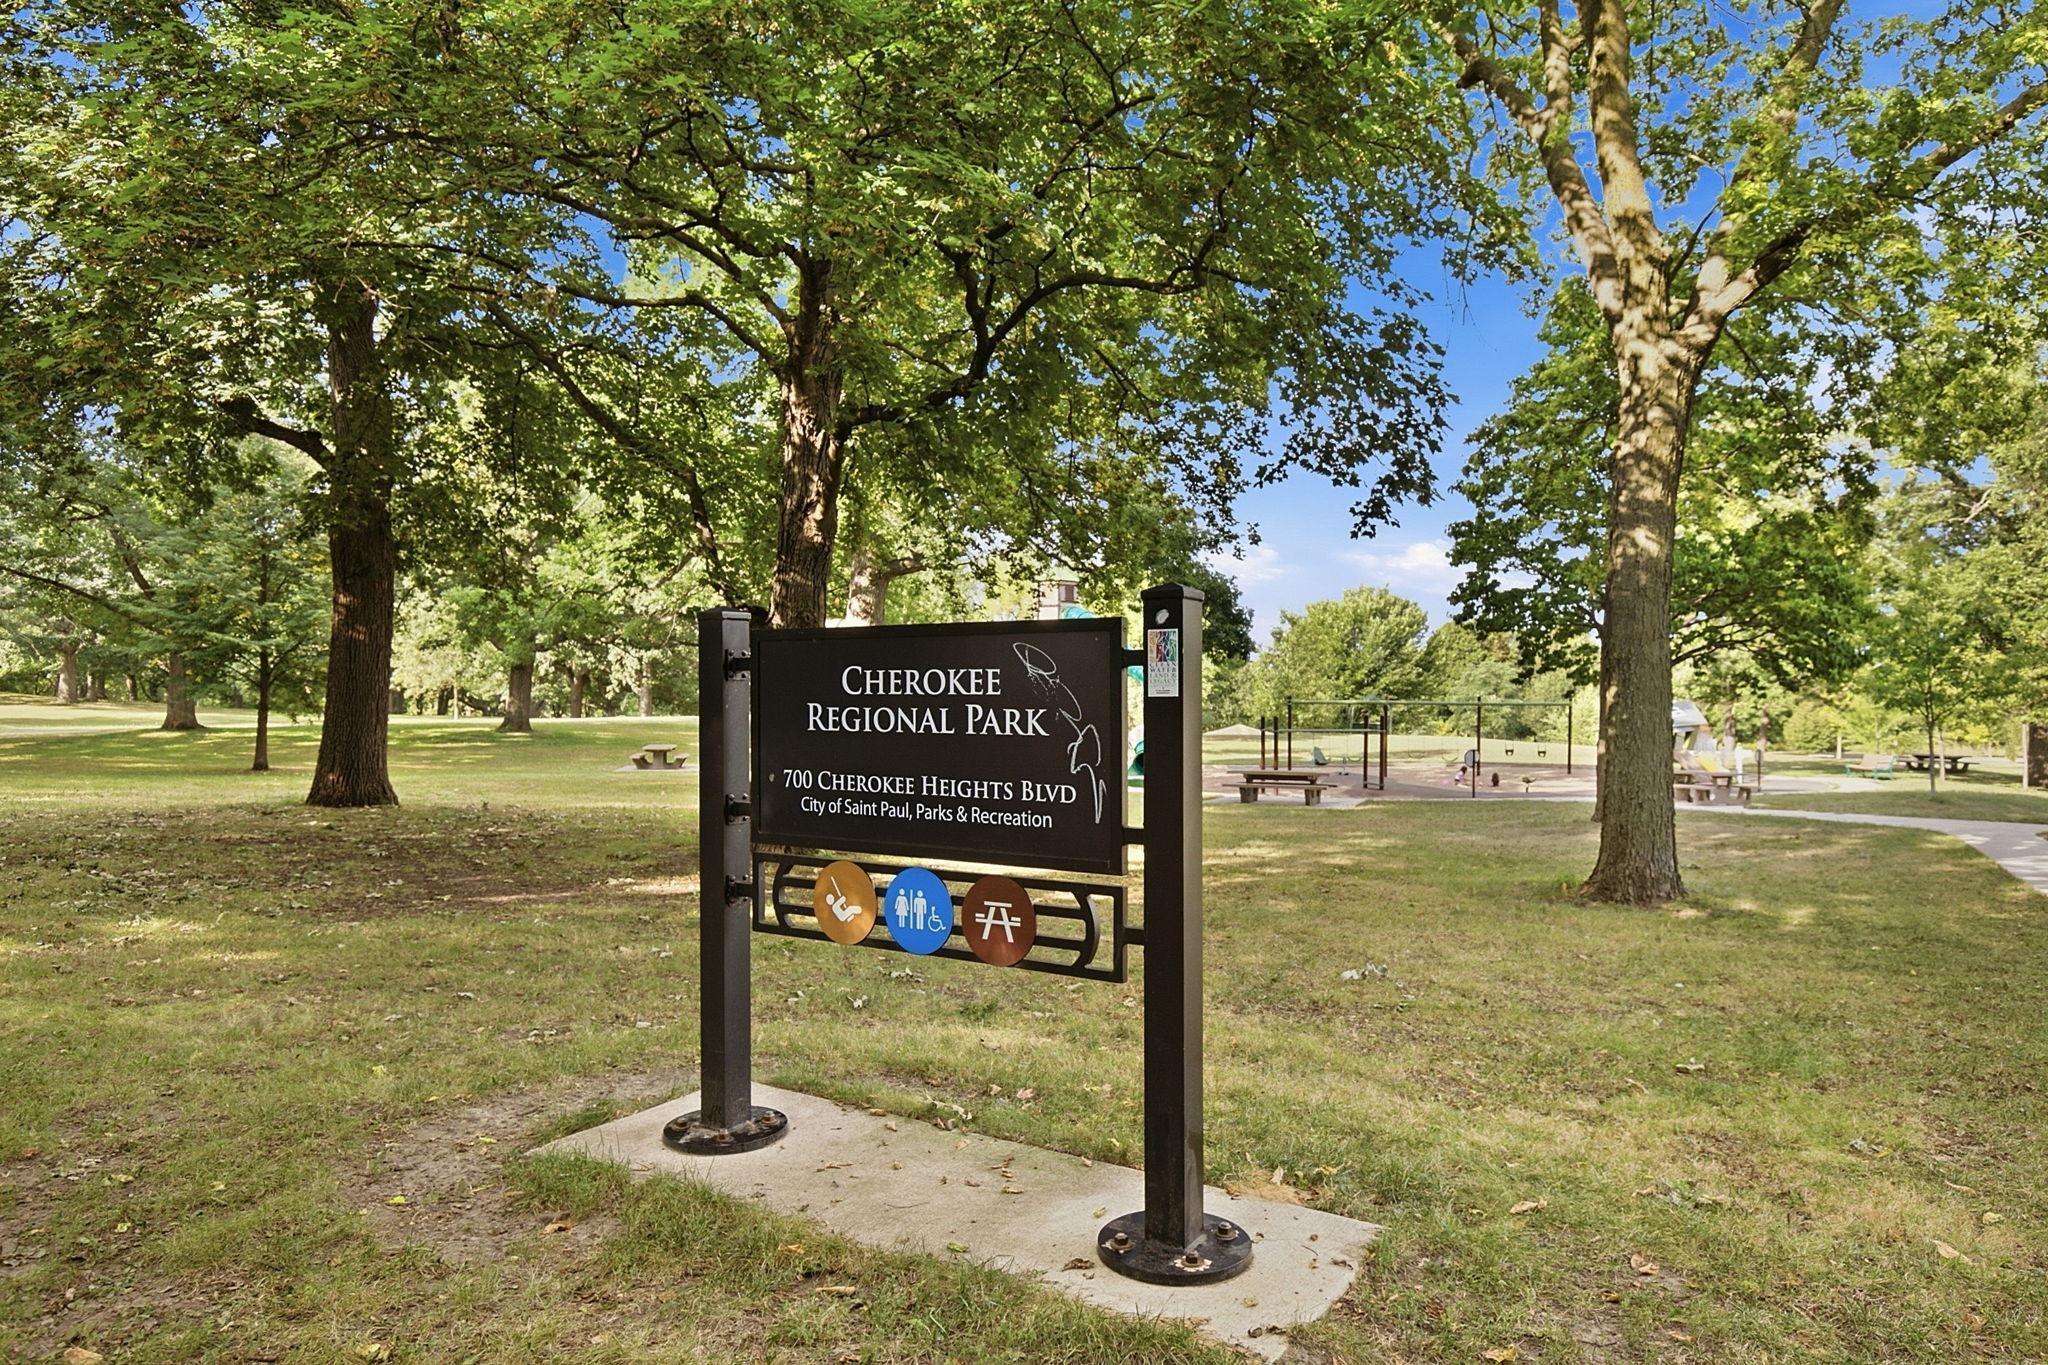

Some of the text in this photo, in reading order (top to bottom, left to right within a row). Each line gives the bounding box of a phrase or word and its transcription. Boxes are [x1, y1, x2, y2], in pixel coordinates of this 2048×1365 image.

[841, 665, 1002, 696] CHEROKEE
[806, 702, 1050, 737] REGIONAL PARK
[783, 769, 1077, 804] 700 CHEROKEE HEIGHTS BLVD
[800, 796, 1053, 829] City of Saint Paul, Parks & Recreation
